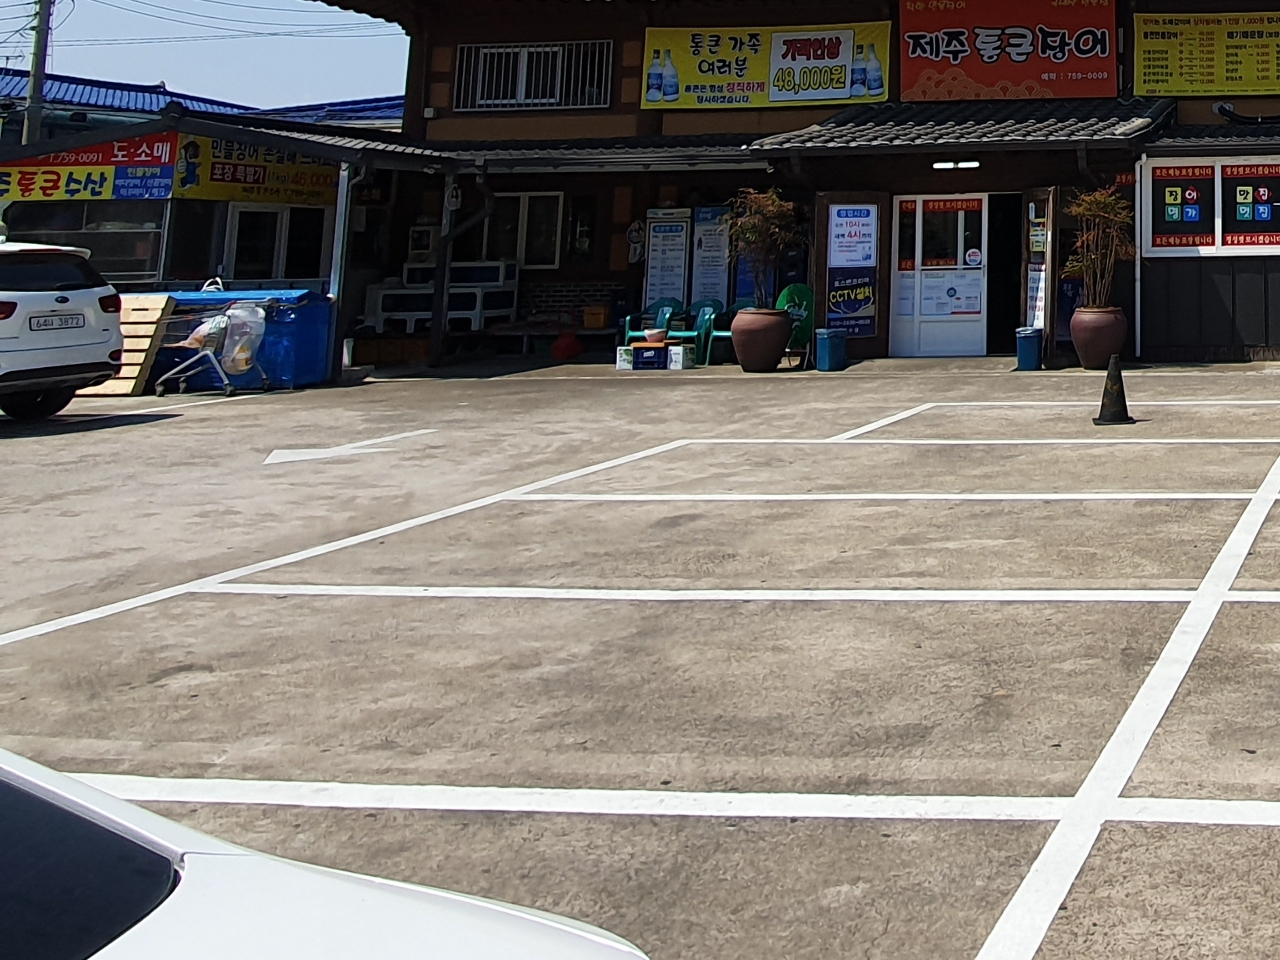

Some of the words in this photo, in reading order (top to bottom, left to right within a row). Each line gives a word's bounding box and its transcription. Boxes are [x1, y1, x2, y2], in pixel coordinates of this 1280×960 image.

[690, 32, 722, 57] 통큰
[727, 32, 762, 55] 가족
[781, 36, 843, 61] 가격인상
[904, 28, 972, 65] 제주
[973, 26, 1035, 62] 통큰
[1036, 24, 1110, 63] 장어
[697, 55, 748, 79] 여러분
[1040, 72, 1057, 81] 예약
[1067, 71, 1109, 81] 759-0009
[725, 82, 766, 94] 정직하게
[773, 64, 847, 95] 48,000원
[109, 141, 171, 164] 도·소매
[211, 139, 260, 162] 민물장어
[213, 163, 235, 181] 포장
[1155, 168, 1168, 177] 모든
[1168, 168, 1180, 178] 메뉴
[1180, 168, 1194, 177] 포장
[1194, 167, 1213, 177] 됩니다
[16, 170, 61, 198] 통큰
[64, 171, 108, 198] 수산
[839, 209, 868, 218] 영업시간
[945, 200, 979, 210] 모시겠습니다
[1155, 235, 1168, 246] 모든
[1168, 235, 1180, 246] 메뉴
[1181, 235, 1194, 246] 포장
[1195, 234, 1214, 245] 됩니다
[1225, 234, 1246, 245] 정성껏
[829, 286, 874, 303] CCTV설치
